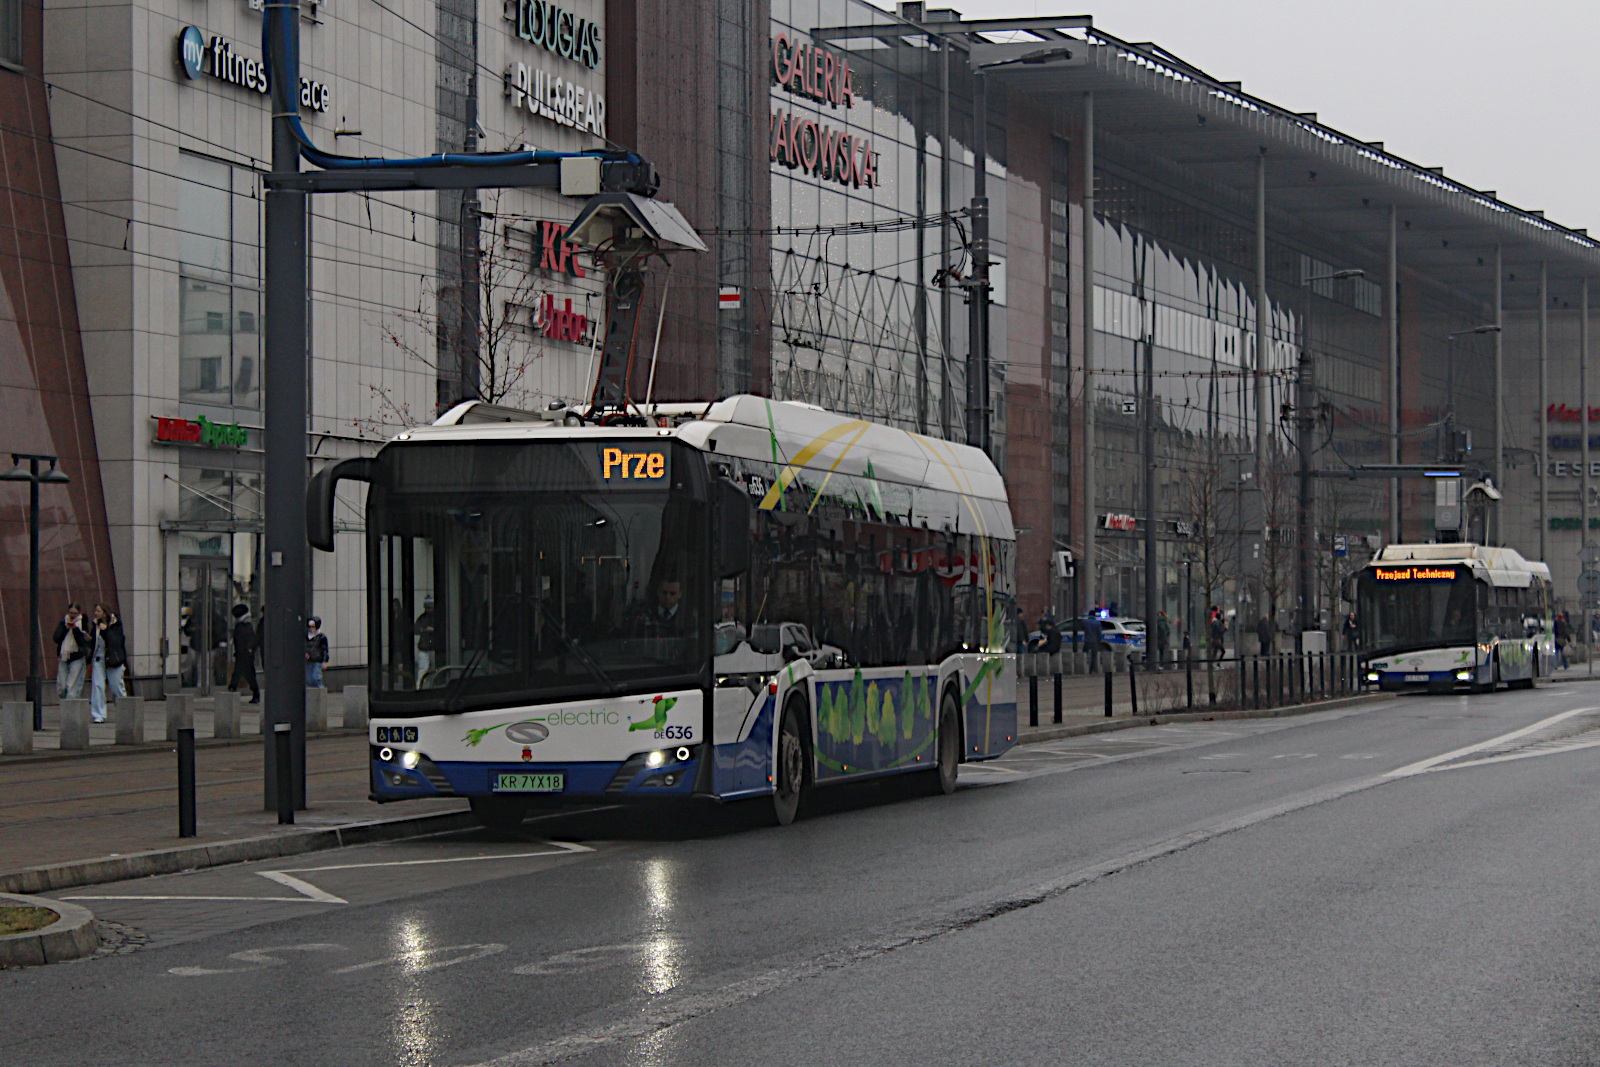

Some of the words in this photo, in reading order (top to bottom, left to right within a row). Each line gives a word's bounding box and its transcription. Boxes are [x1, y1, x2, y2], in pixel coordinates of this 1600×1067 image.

[519, 0, 600, 69] DOUGLAS
[183, 38, 204, 71] my
[213, 36, 268, 94] fitnes
[301, 77, 330, 113] ace
[774, 32, 854, 110] GALERIA
[517, 61, 607, 140] PULL&BEAR
[770, 108, 875, 189] AKOWSKA
[603, 447, 665, 479] Prze
[1376, 568, 1411, 580] Przejazd
[1412, 567, 1455, 580] Techniczny
[547, 708, 620, 726] electric
[654, 725, 693, 740] DE636
[501, 775, 518, 789] KR
[522, 775, 561, 789] 7YX18
